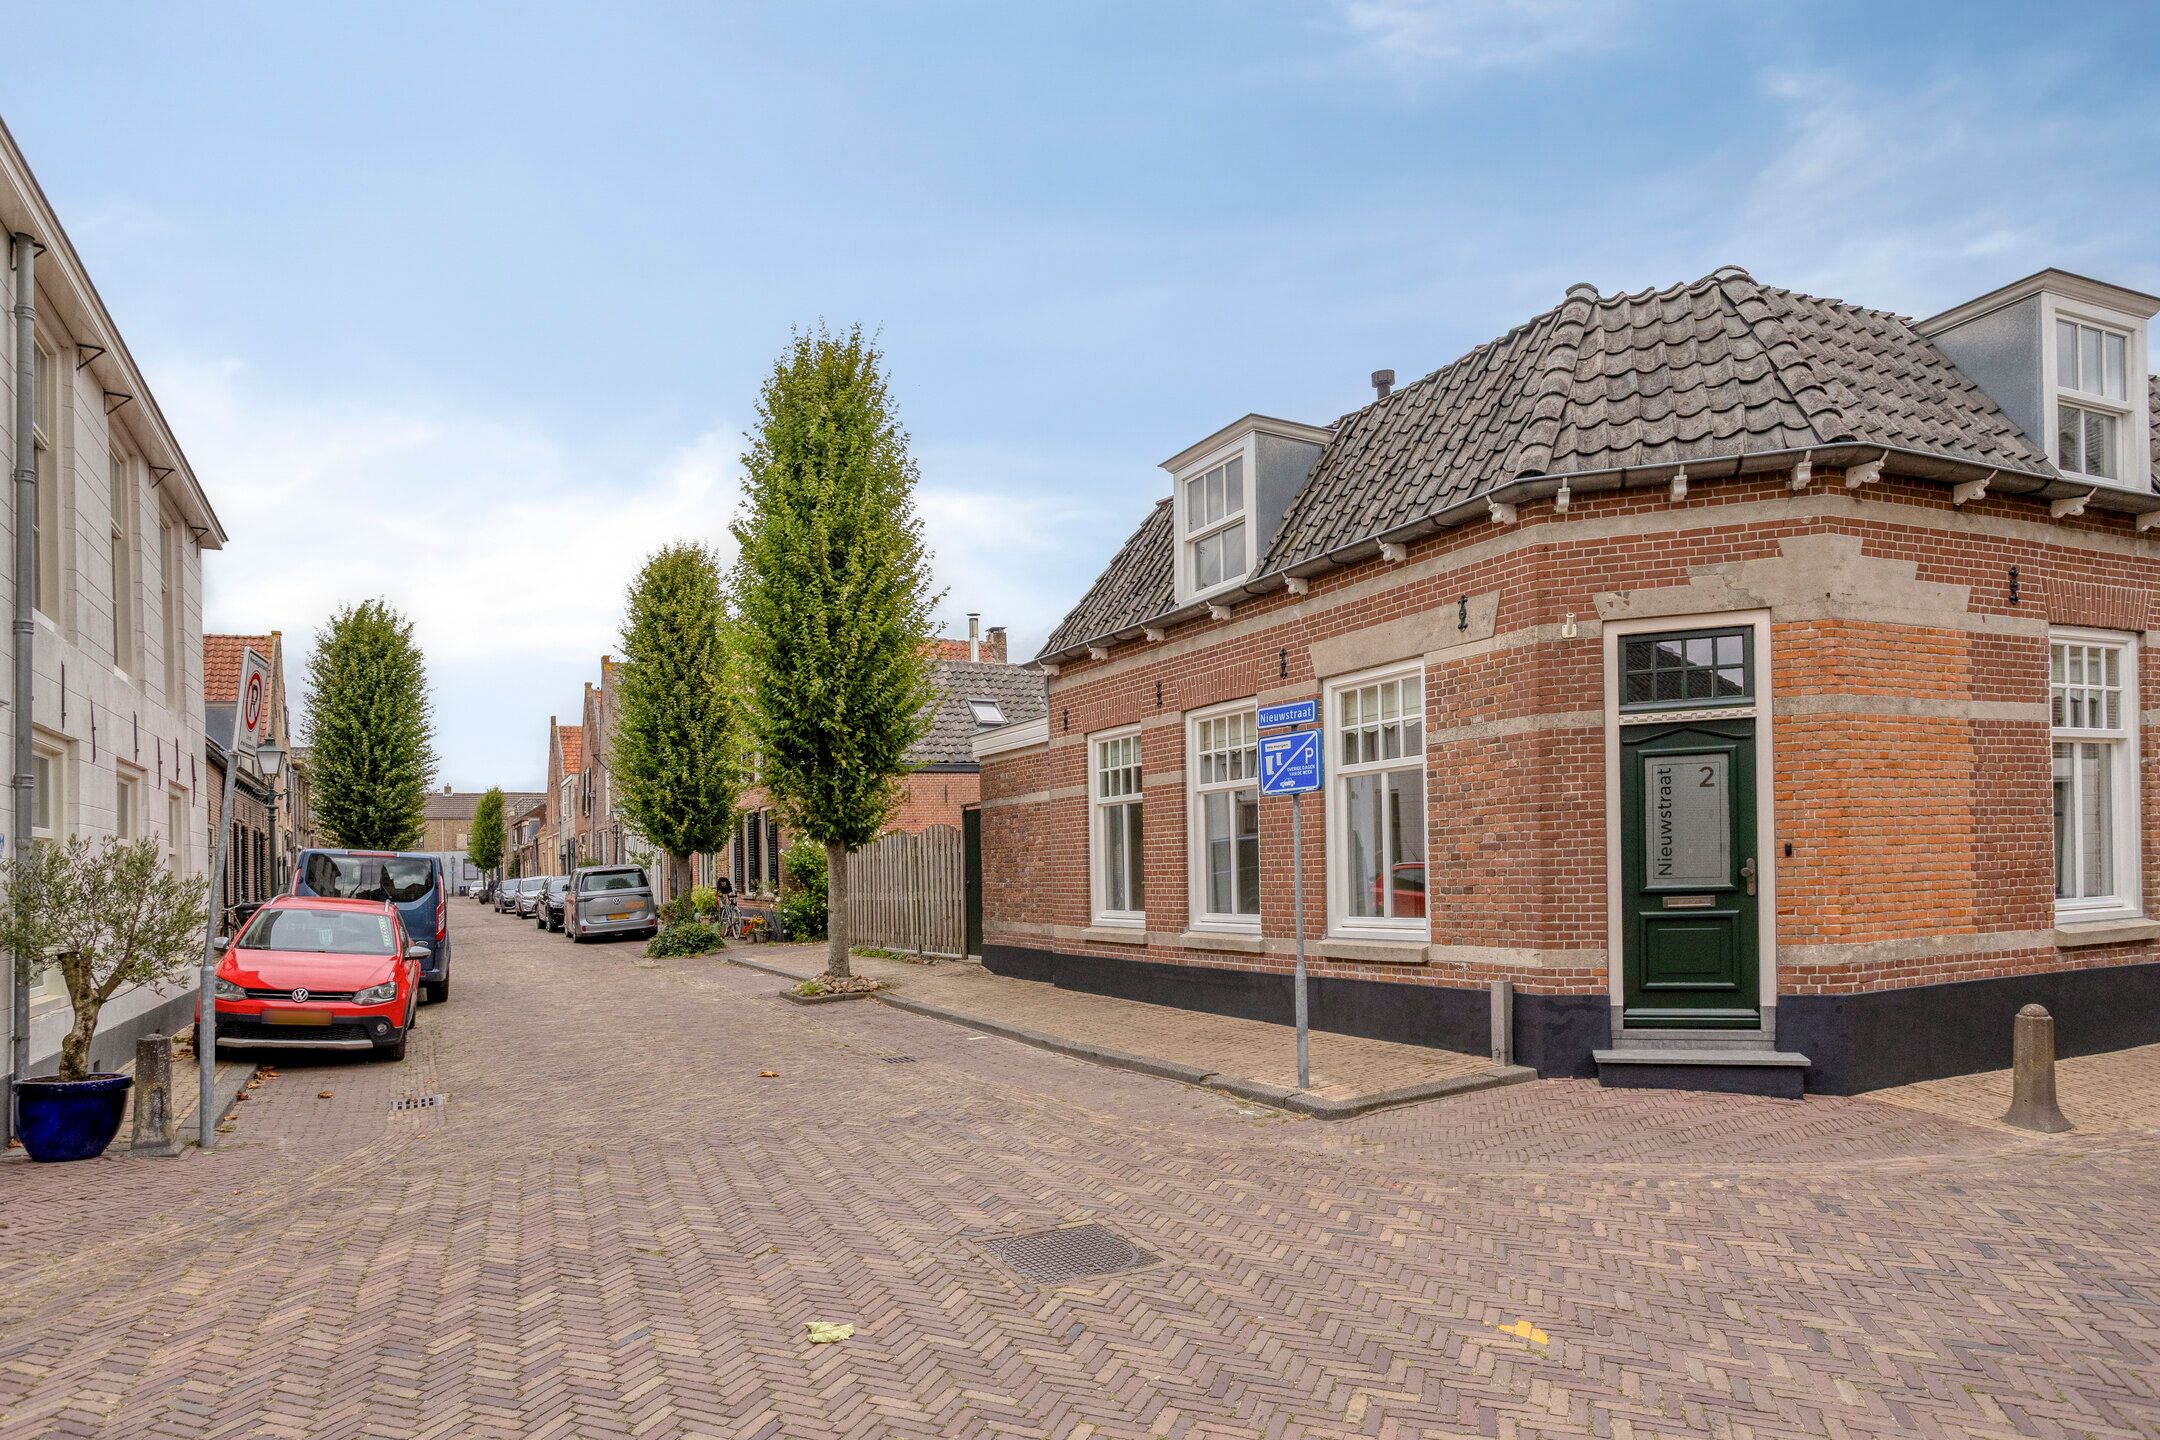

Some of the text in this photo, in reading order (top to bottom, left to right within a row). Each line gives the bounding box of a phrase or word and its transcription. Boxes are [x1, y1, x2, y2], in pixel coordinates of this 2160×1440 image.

[1260, 706, 1312, 724] Nieuwstraat
[1305, 747, 1314, 764] P
[1699, 766, 1715, 787] 2
[1657, 767, 1672, 876] Nieuwstraat
